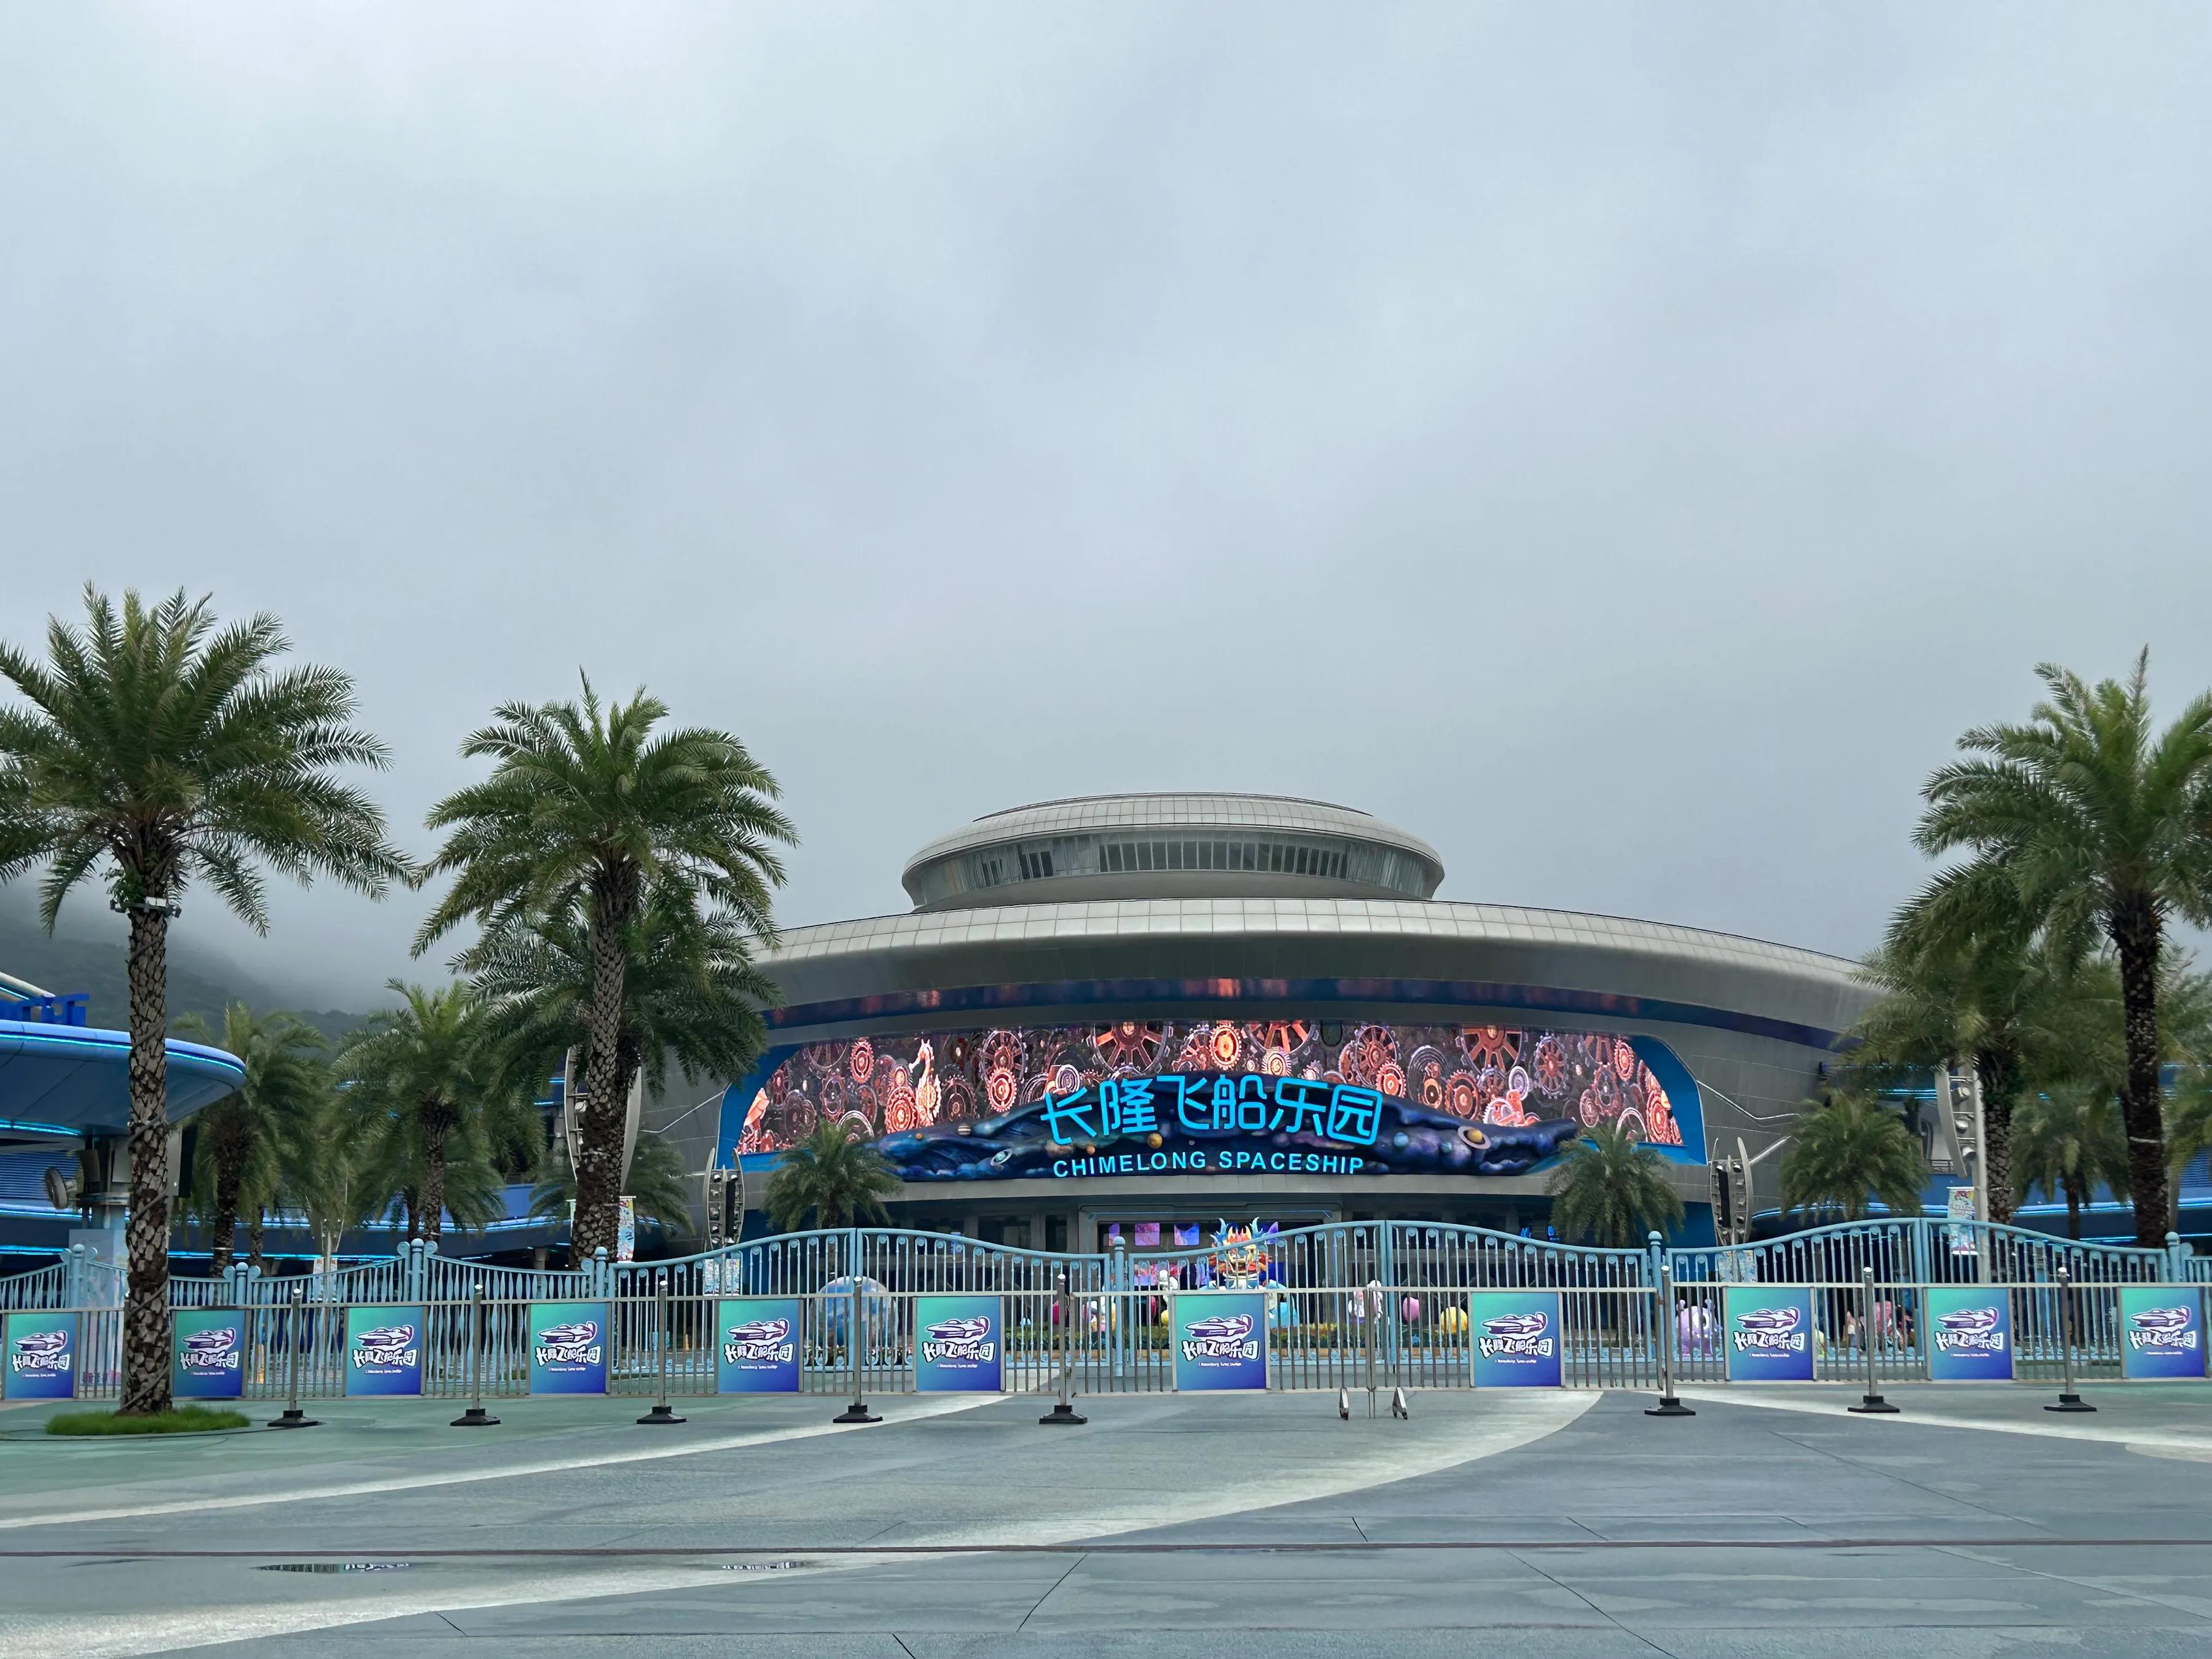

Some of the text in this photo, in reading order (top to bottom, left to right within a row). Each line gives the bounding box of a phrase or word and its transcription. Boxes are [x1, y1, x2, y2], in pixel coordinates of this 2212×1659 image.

[1040, 1074, 1383, 1145] 长隆飞船乐园
[1053, 1151, 1365, 1178] CHIMELONG SPACESHIP
